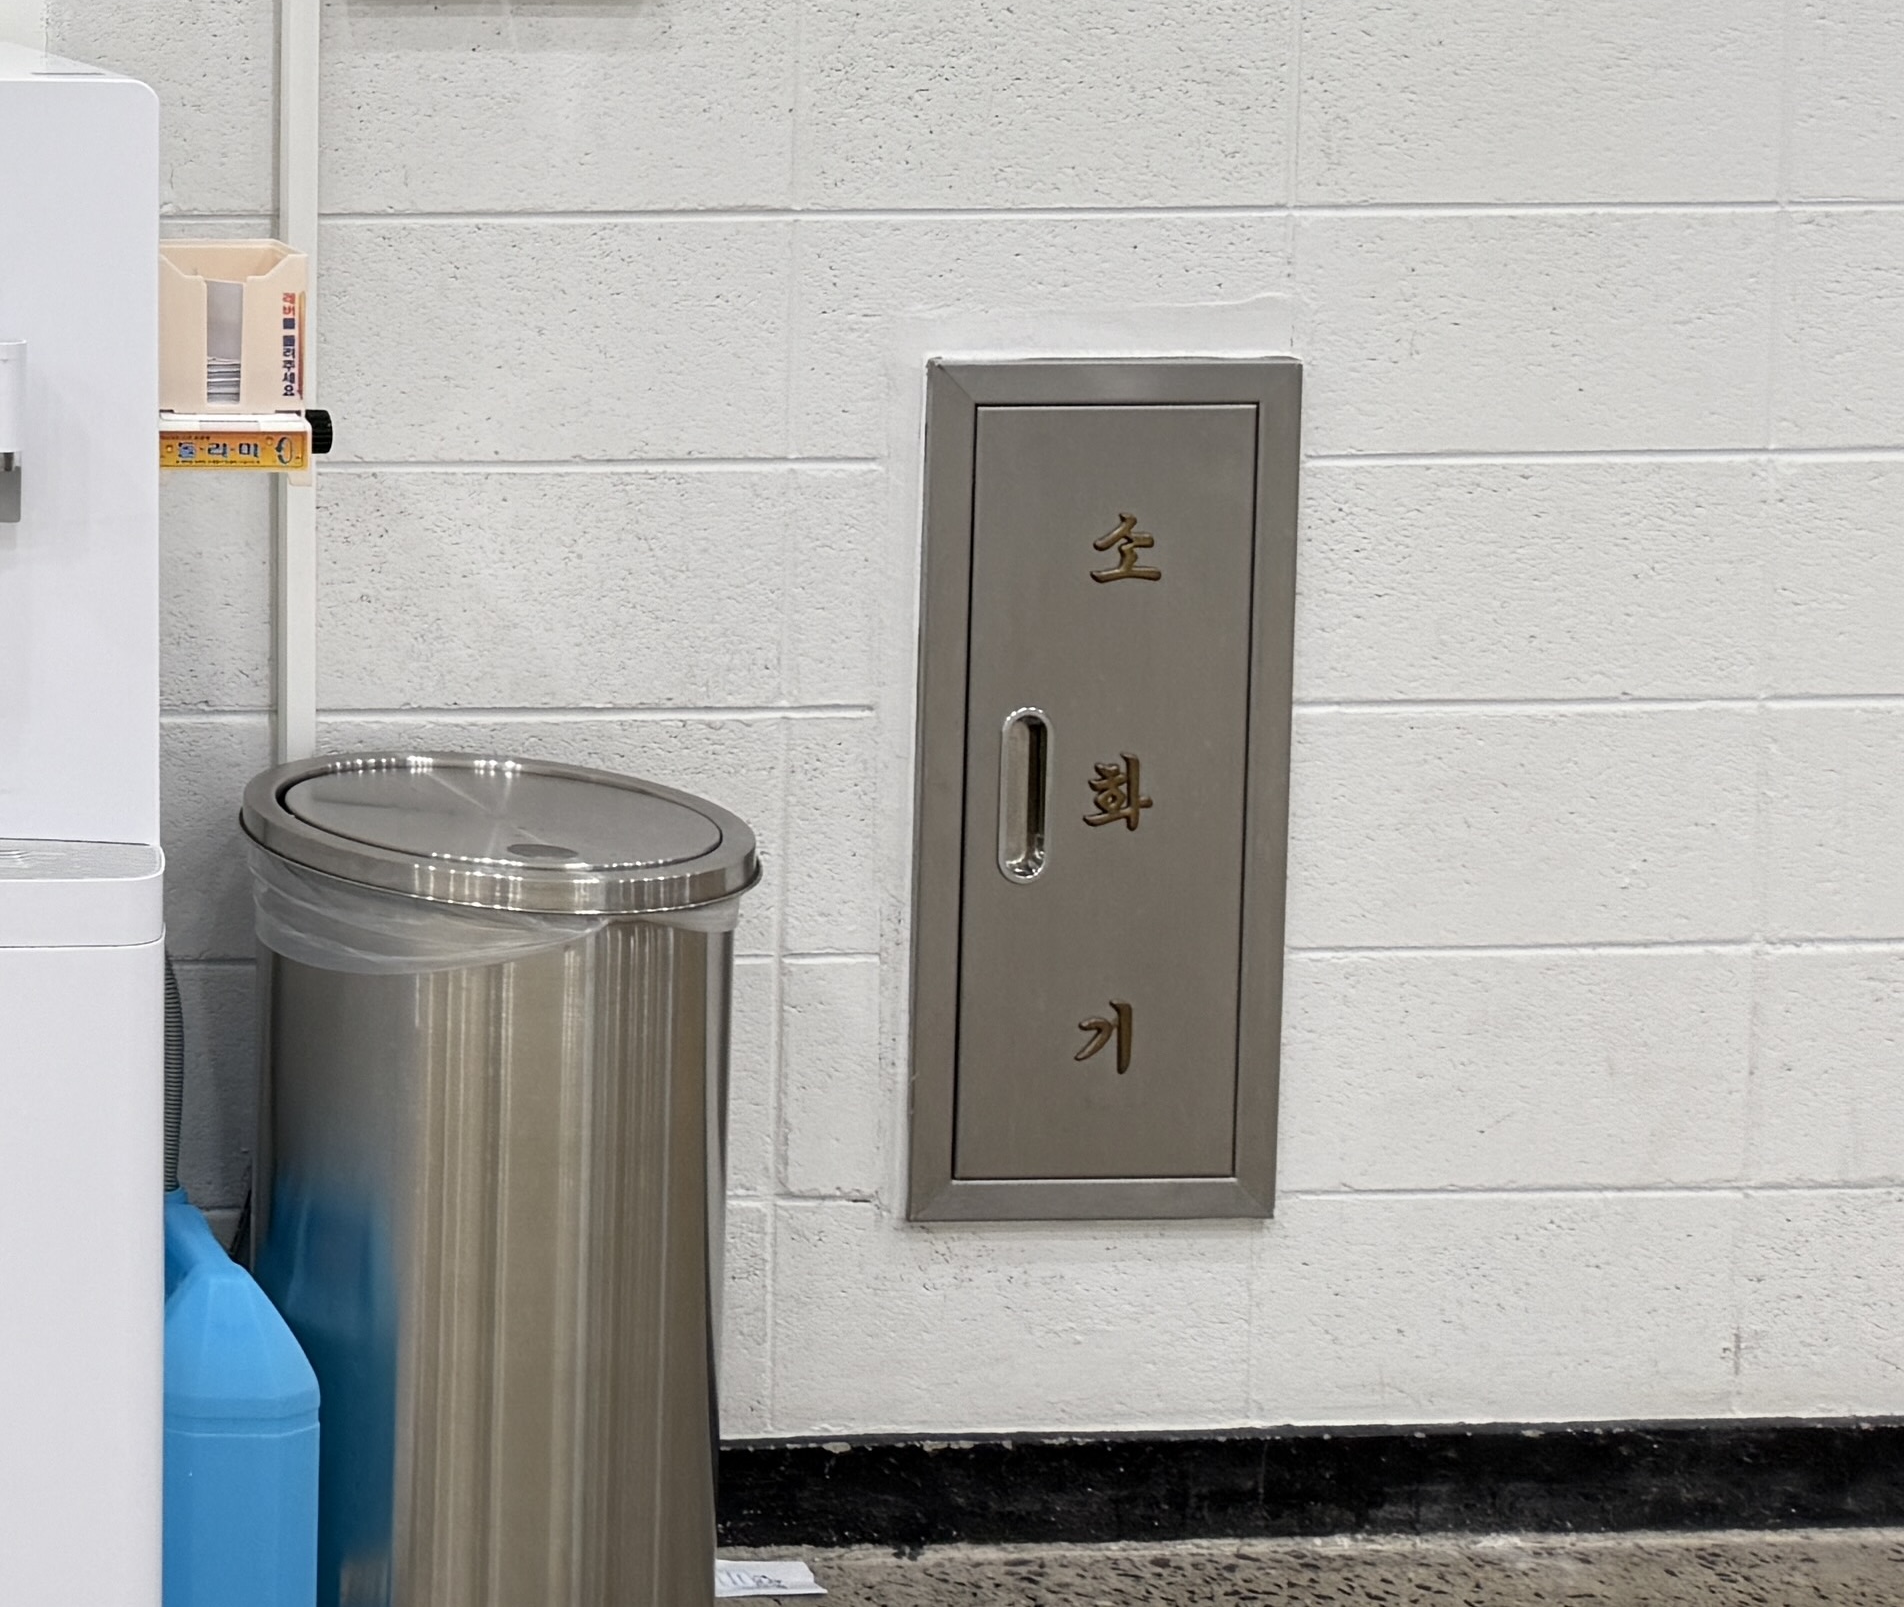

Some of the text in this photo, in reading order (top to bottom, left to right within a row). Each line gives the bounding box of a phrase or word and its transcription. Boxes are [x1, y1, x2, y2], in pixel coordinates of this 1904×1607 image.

[282, 292, 297, 397] 레버 려주세요
[1072, 512, 1163, 1077] 소화기
